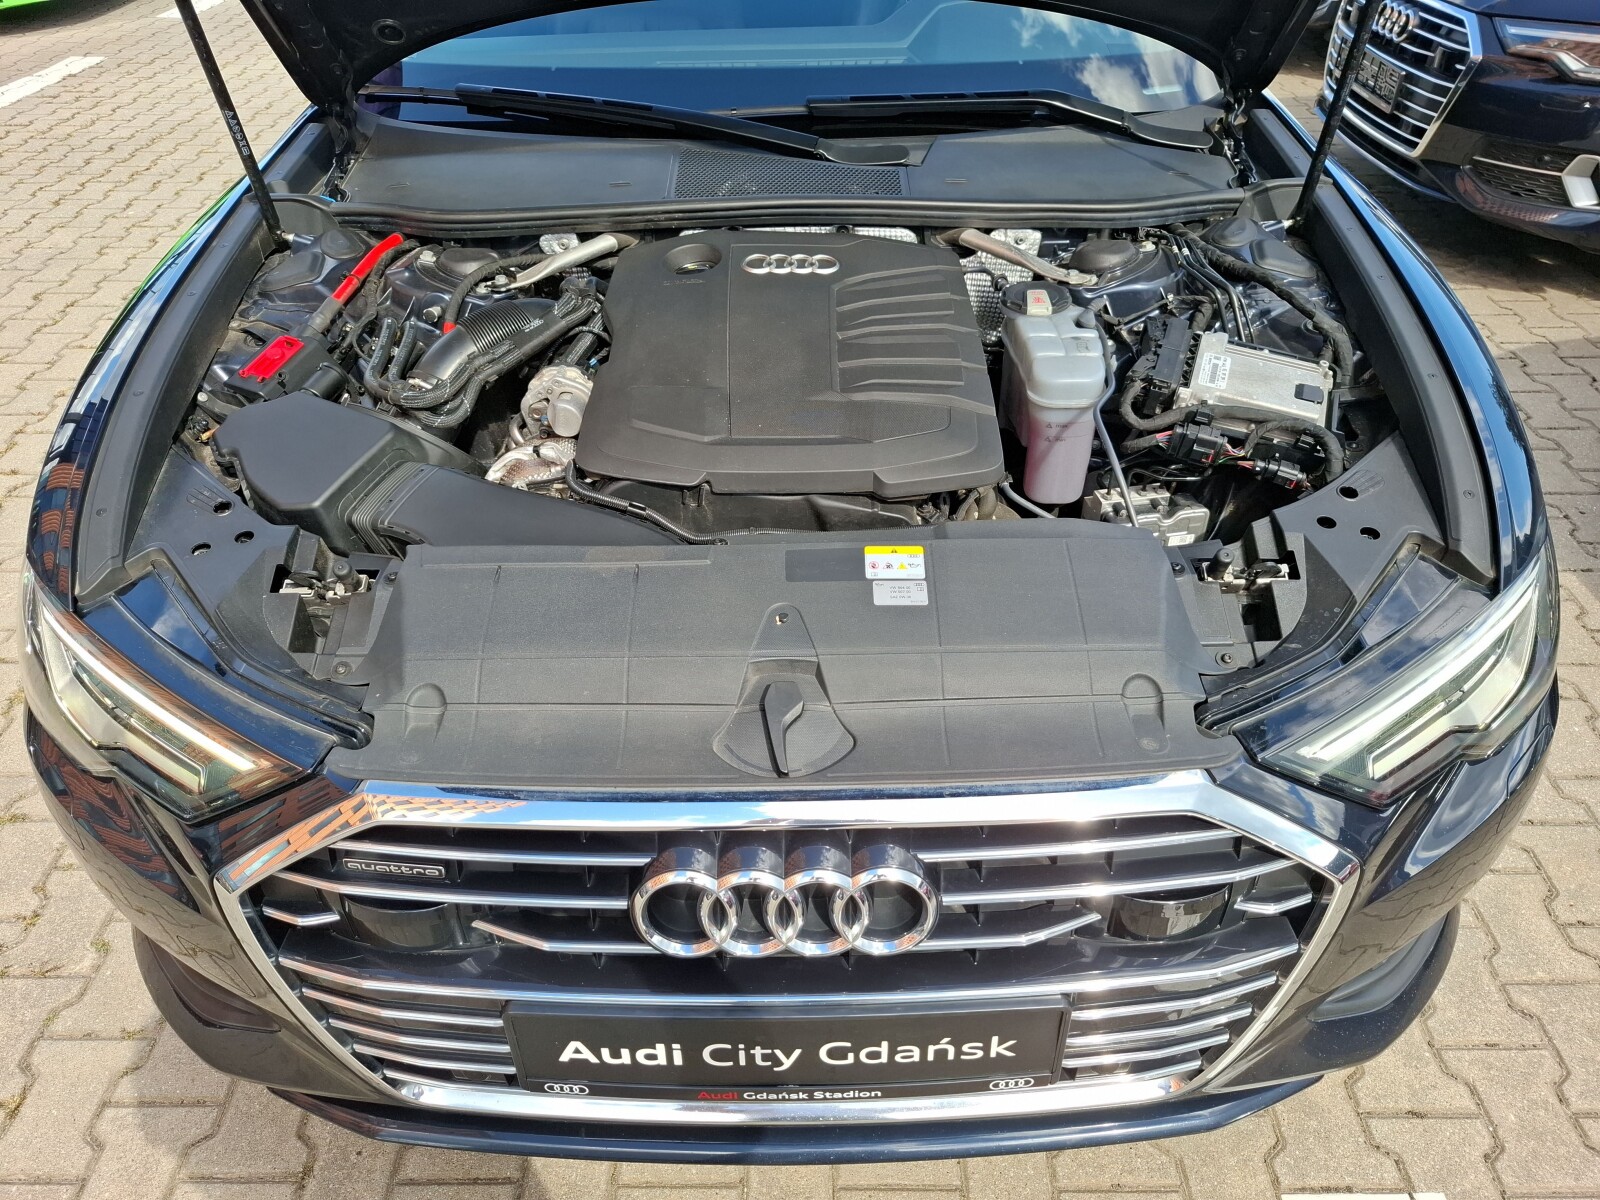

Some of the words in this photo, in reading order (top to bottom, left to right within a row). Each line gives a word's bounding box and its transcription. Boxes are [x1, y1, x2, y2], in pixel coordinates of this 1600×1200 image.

[347, 862, 440, 876] quattro
[558, 1040, 684, 1066] Audi
[702, 1043, 803, 1072] City
[818, 1035, 1018, 1065] Gdańsk
[697, 1091, 738, 1100] Audi
[743, 1091, 809, 1100] Gdańsk
[813, 1089, 882, 1099] Stadion
